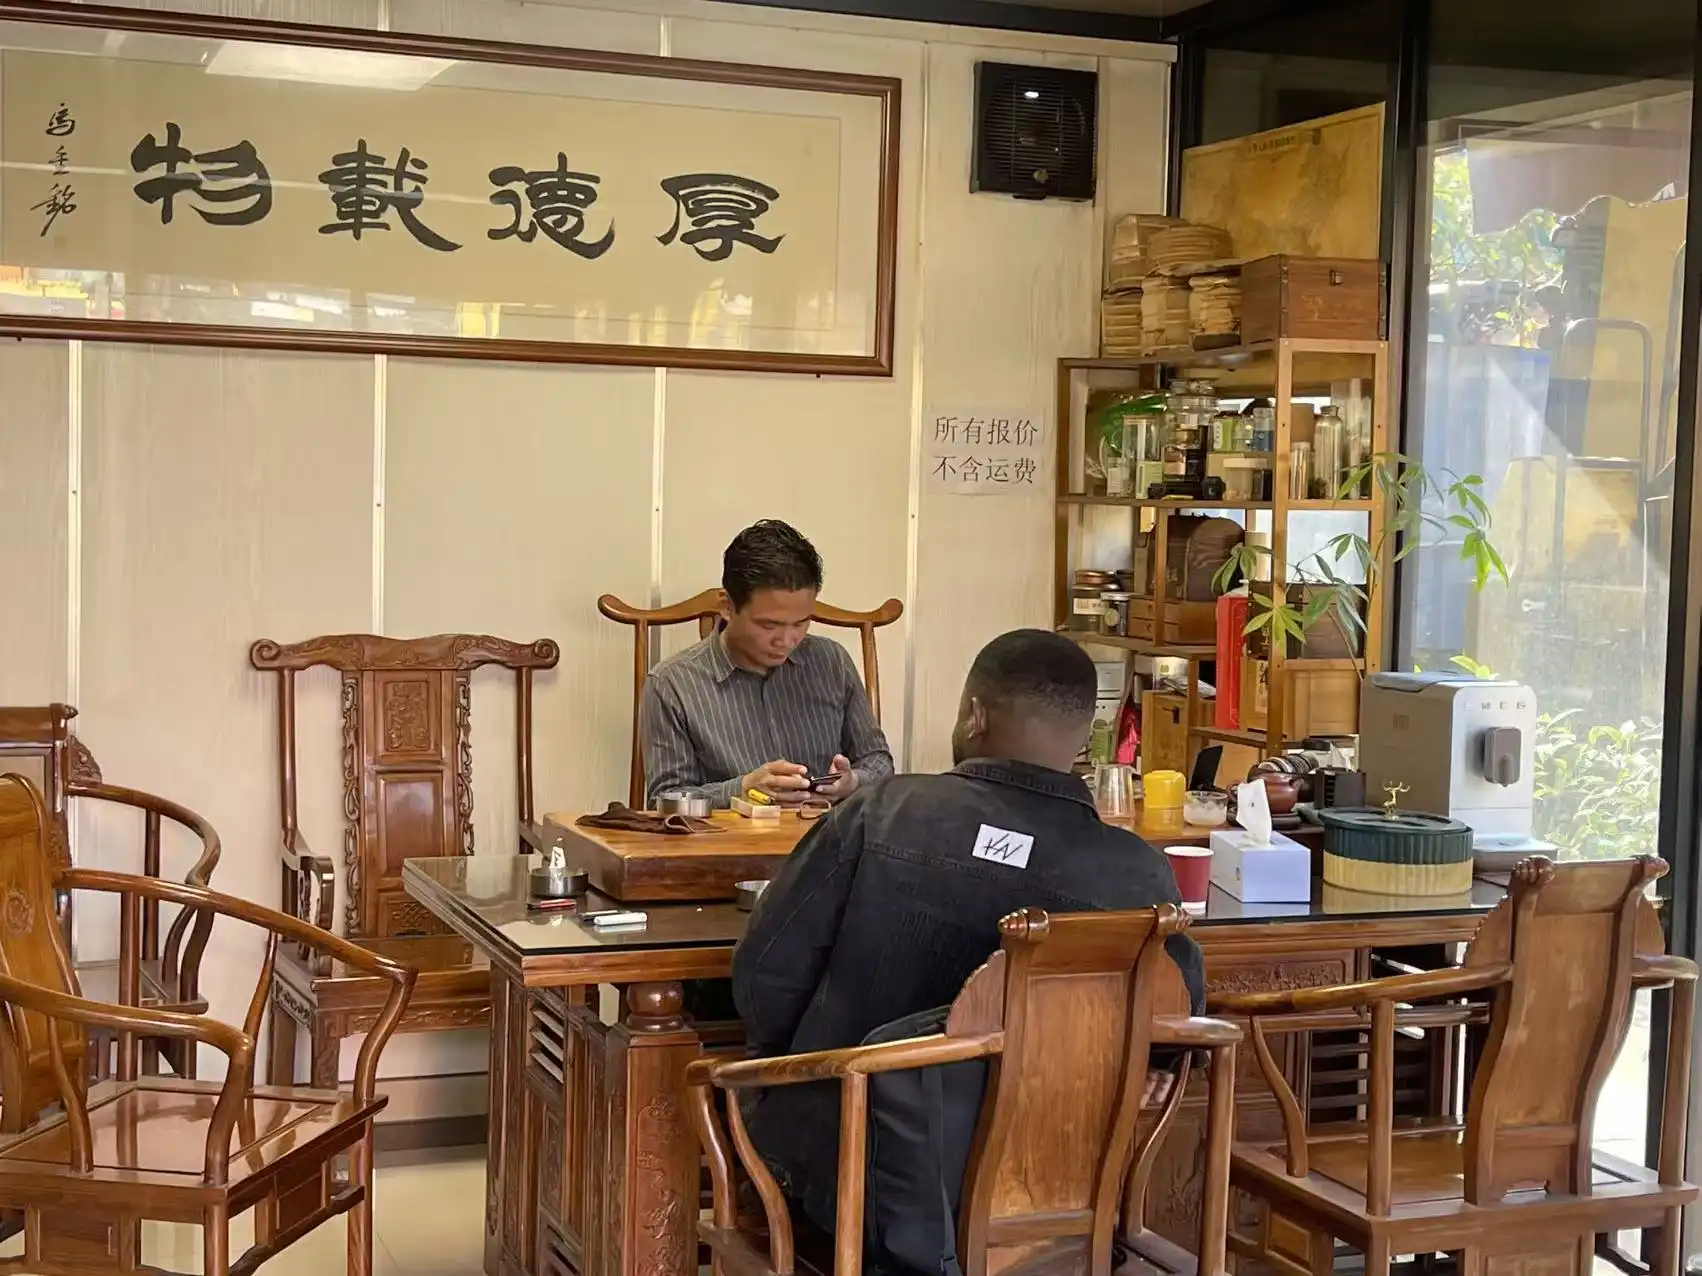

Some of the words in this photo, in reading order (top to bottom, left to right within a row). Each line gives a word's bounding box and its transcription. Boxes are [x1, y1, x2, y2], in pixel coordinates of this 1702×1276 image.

[934, 416, 1039, 446] 所有报价
[932, 456, 1036, 484] 不含运费
